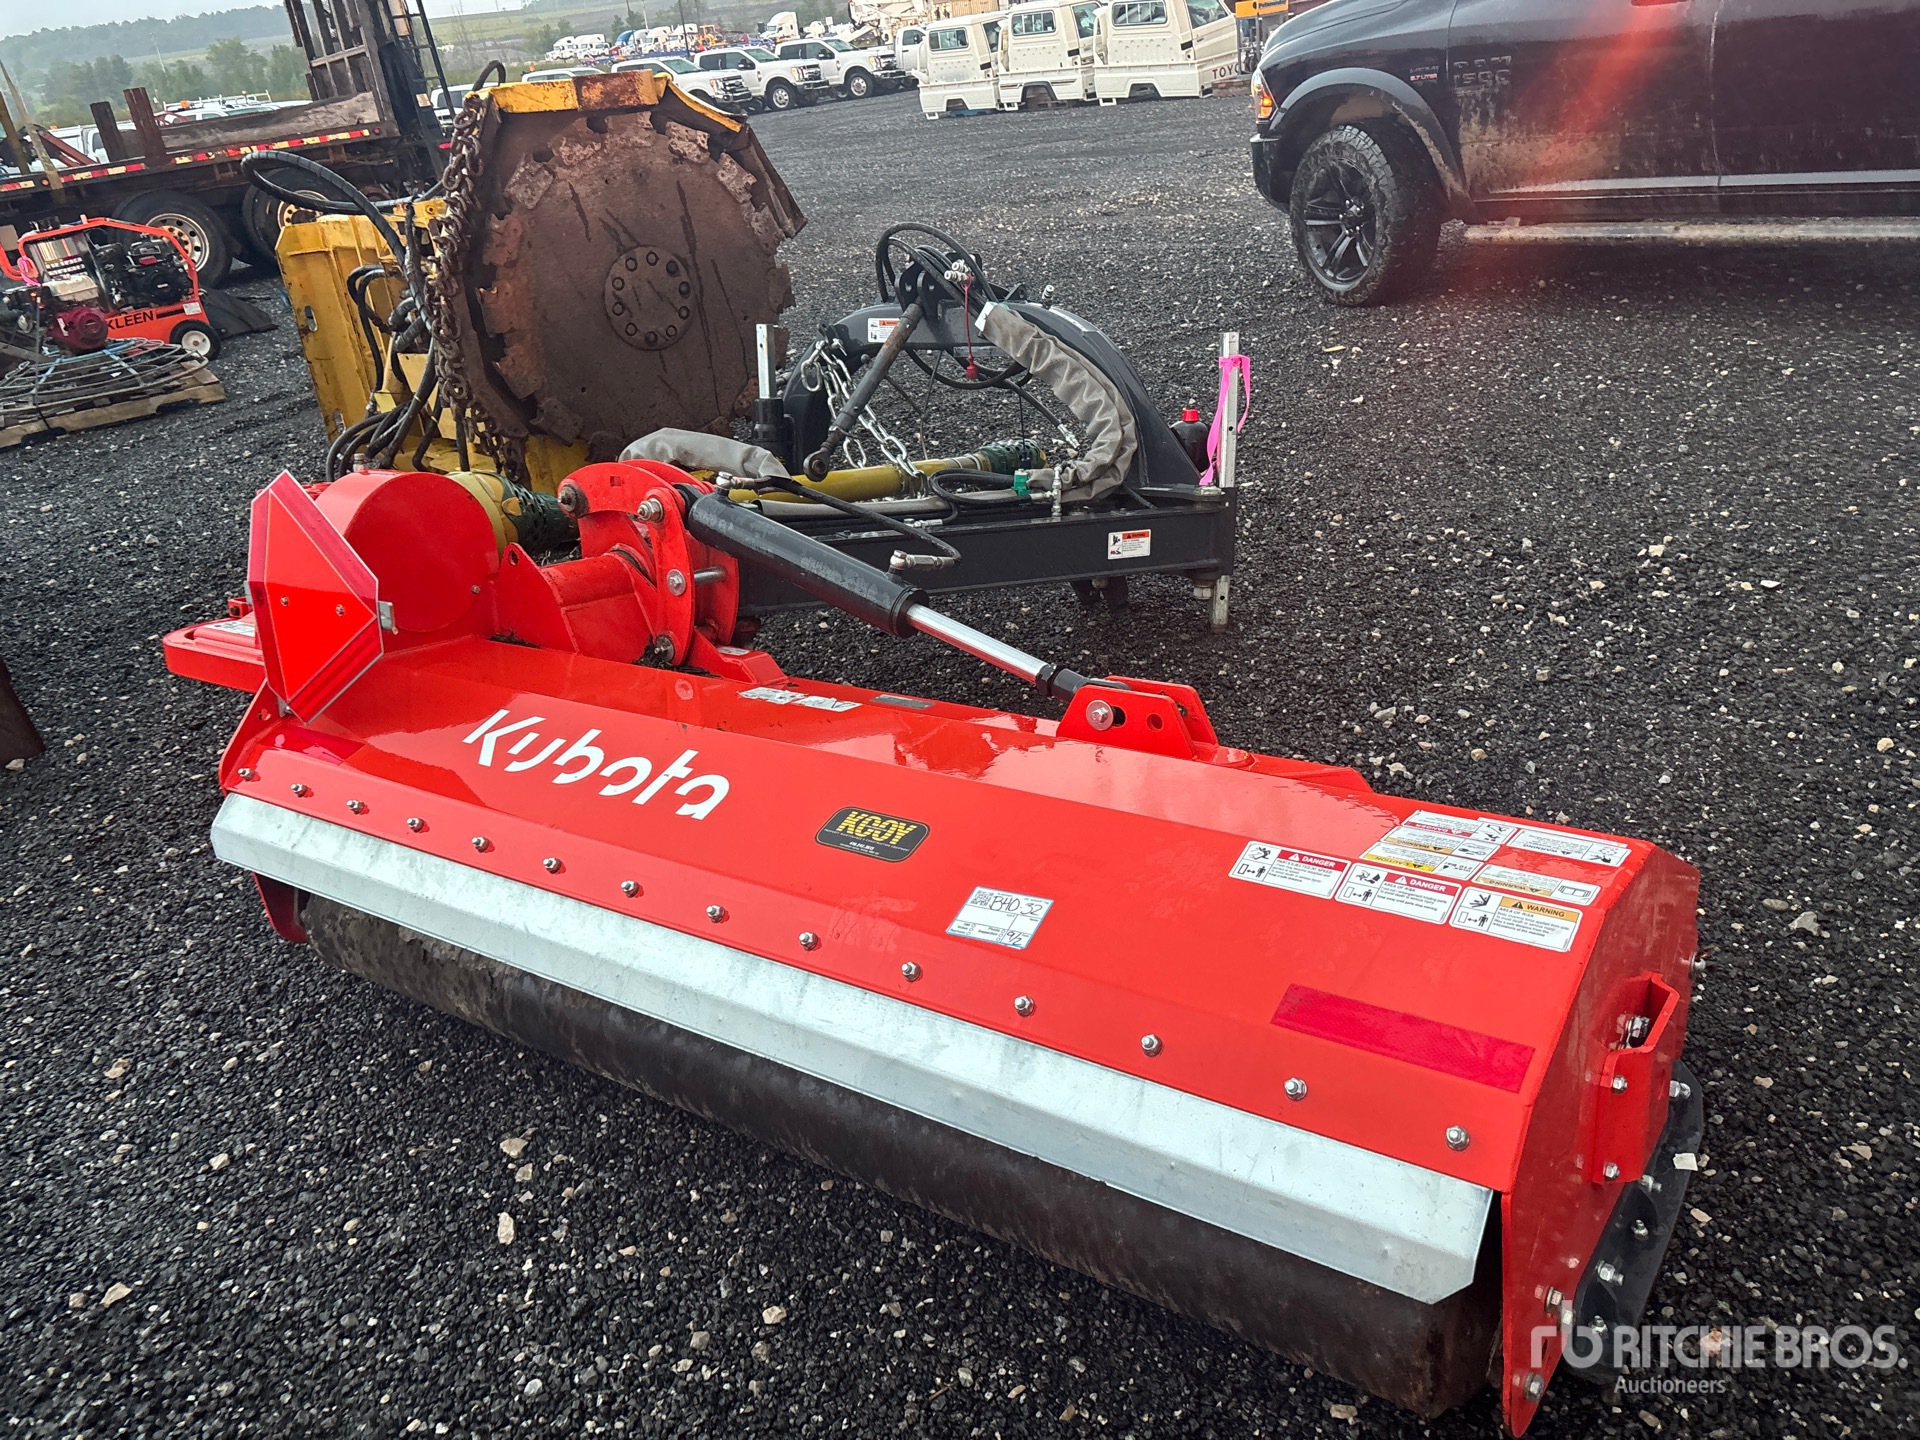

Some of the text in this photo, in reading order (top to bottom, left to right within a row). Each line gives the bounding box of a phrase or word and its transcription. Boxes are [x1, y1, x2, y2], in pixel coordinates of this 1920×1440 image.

[462, 709, 730, 820] Kubota
[836, 811, 918, 845] KOOY
[1301, 856, 1336, 867] DANGER
[1409, 879, 1446, 891] DANGER
[1489, 880, 1525, 890] WARNING
[1526, 904, 1565, 917] WARNING
